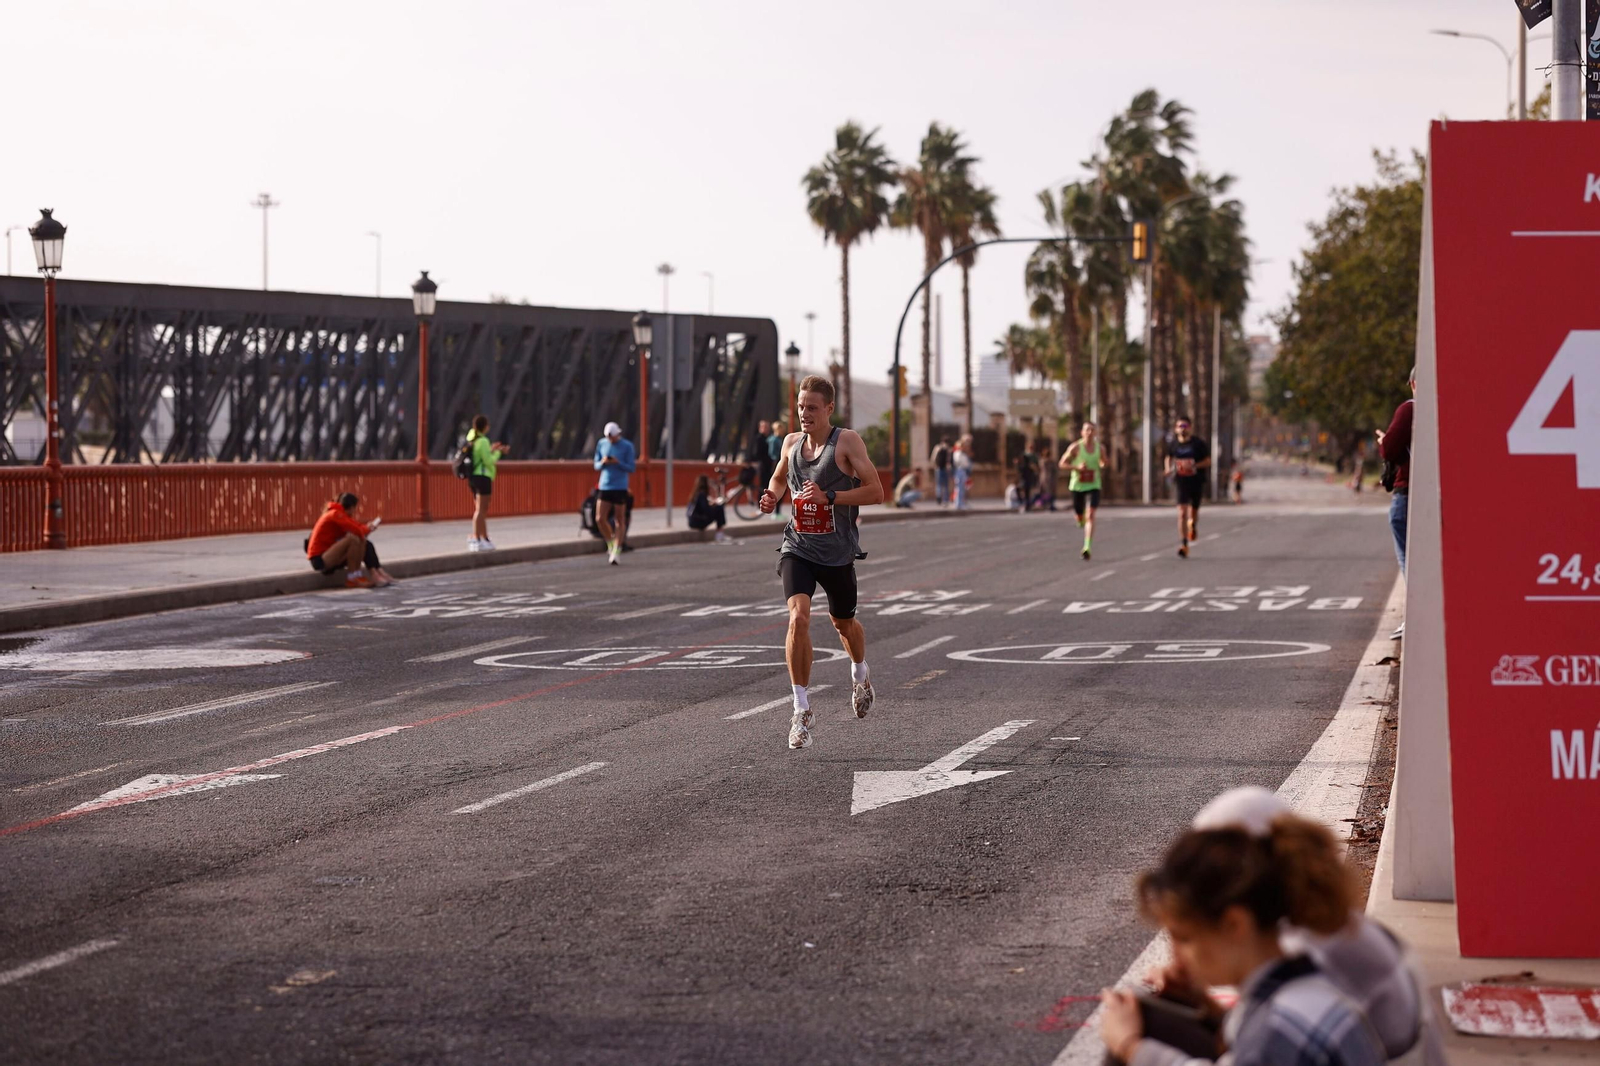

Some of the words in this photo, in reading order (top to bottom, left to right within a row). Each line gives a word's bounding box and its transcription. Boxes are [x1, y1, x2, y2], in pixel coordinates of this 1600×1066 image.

[802, 503, 818, 512] 443
[1150, 585, 1310, 598] RED
[1062, 597, 1364, 613] BASICA
[563, 649, 767, 665] 50
[1040, 642, 1229, 660] 50
